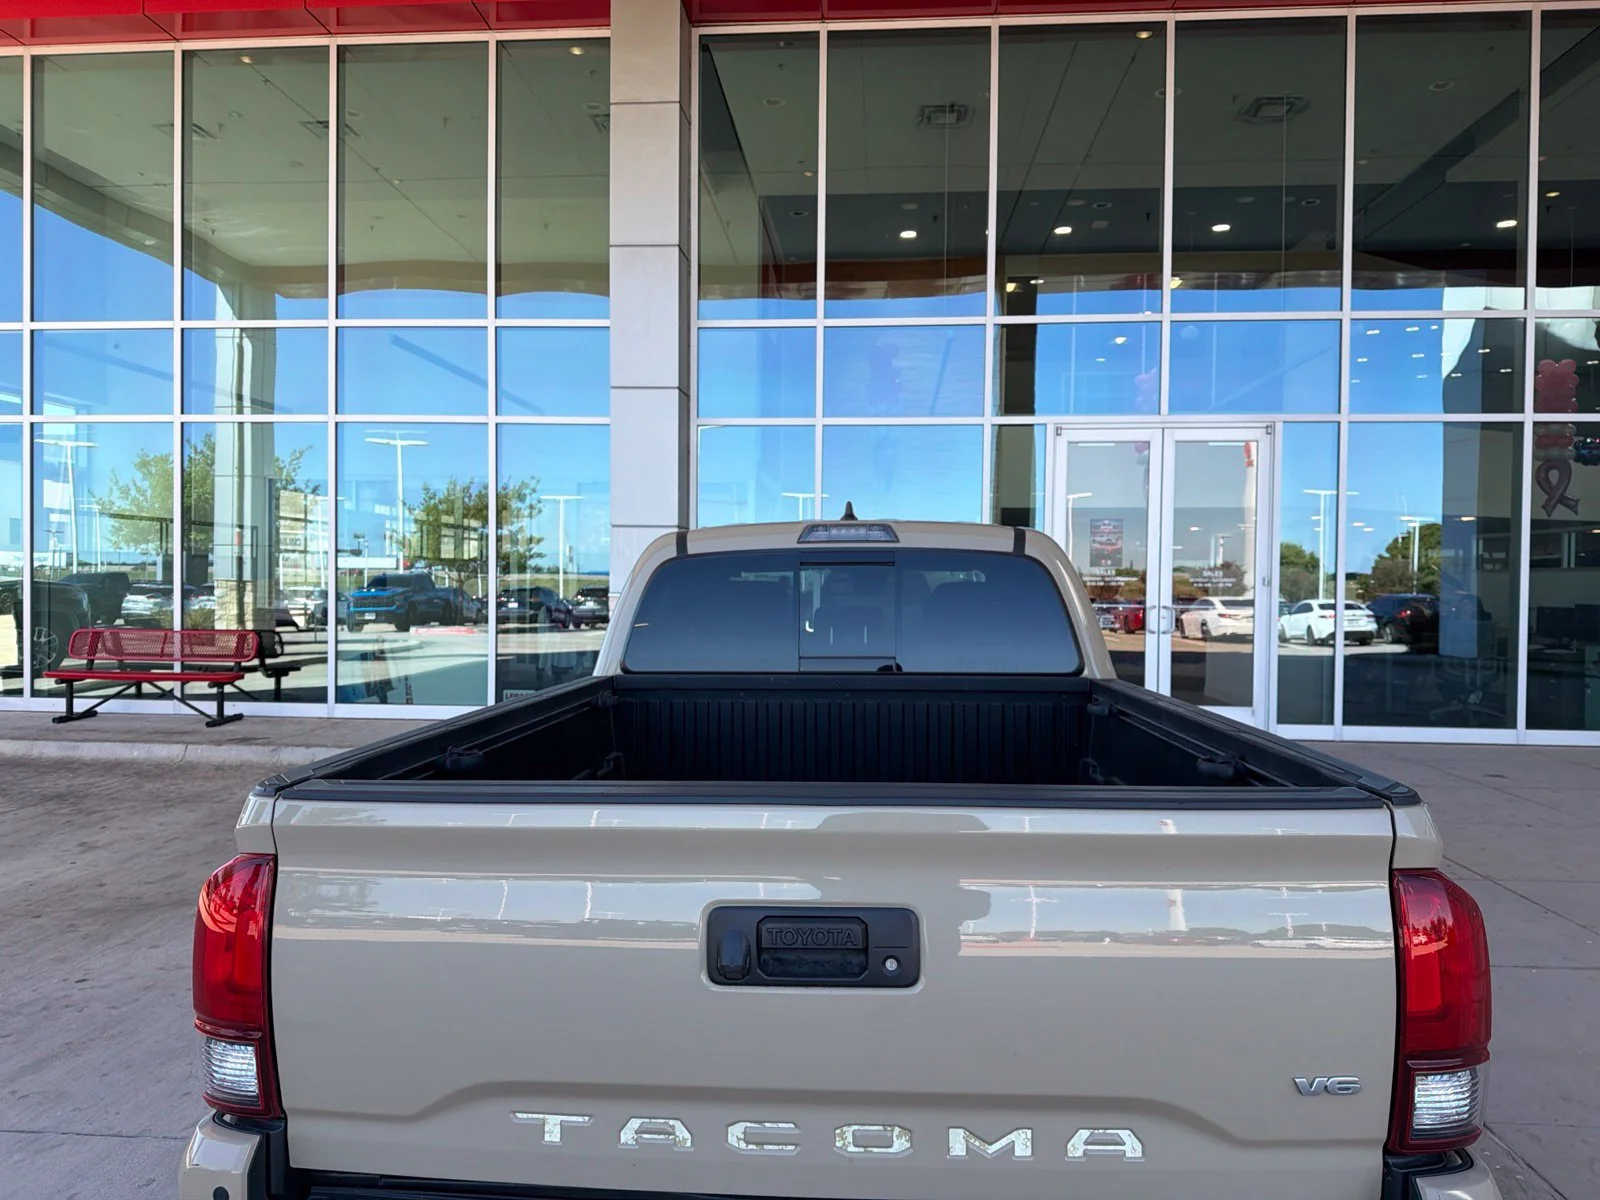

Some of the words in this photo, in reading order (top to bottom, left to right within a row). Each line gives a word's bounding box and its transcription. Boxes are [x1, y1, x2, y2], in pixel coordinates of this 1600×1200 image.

[766, 927, 858, 947] TOYOTA
[1293, 1075, 1361, 1096] V6
[510, 1111, 1146, 1161] TACOMA
